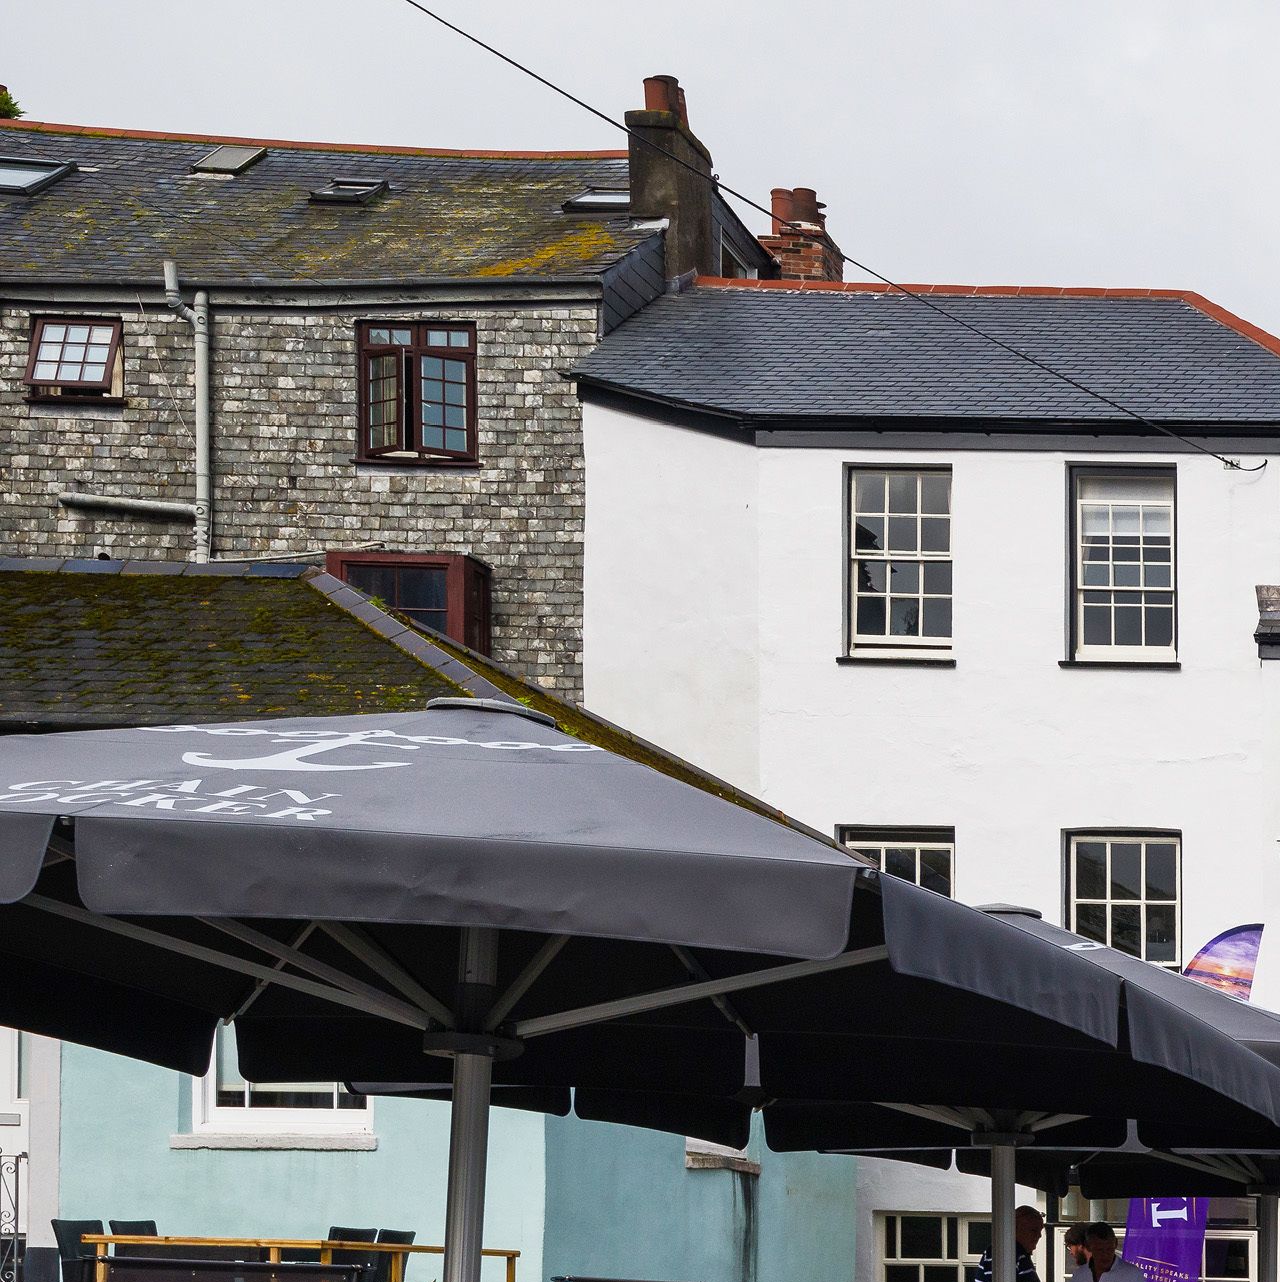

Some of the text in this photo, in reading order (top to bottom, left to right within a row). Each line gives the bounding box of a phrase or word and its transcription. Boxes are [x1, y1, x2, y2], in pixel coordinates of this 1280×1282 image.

[8, 779, 343, 804] CHAIN
[0, 792, 333, 821] OCKER
[1160, 1268, 1189, 1280] SPEAKS
